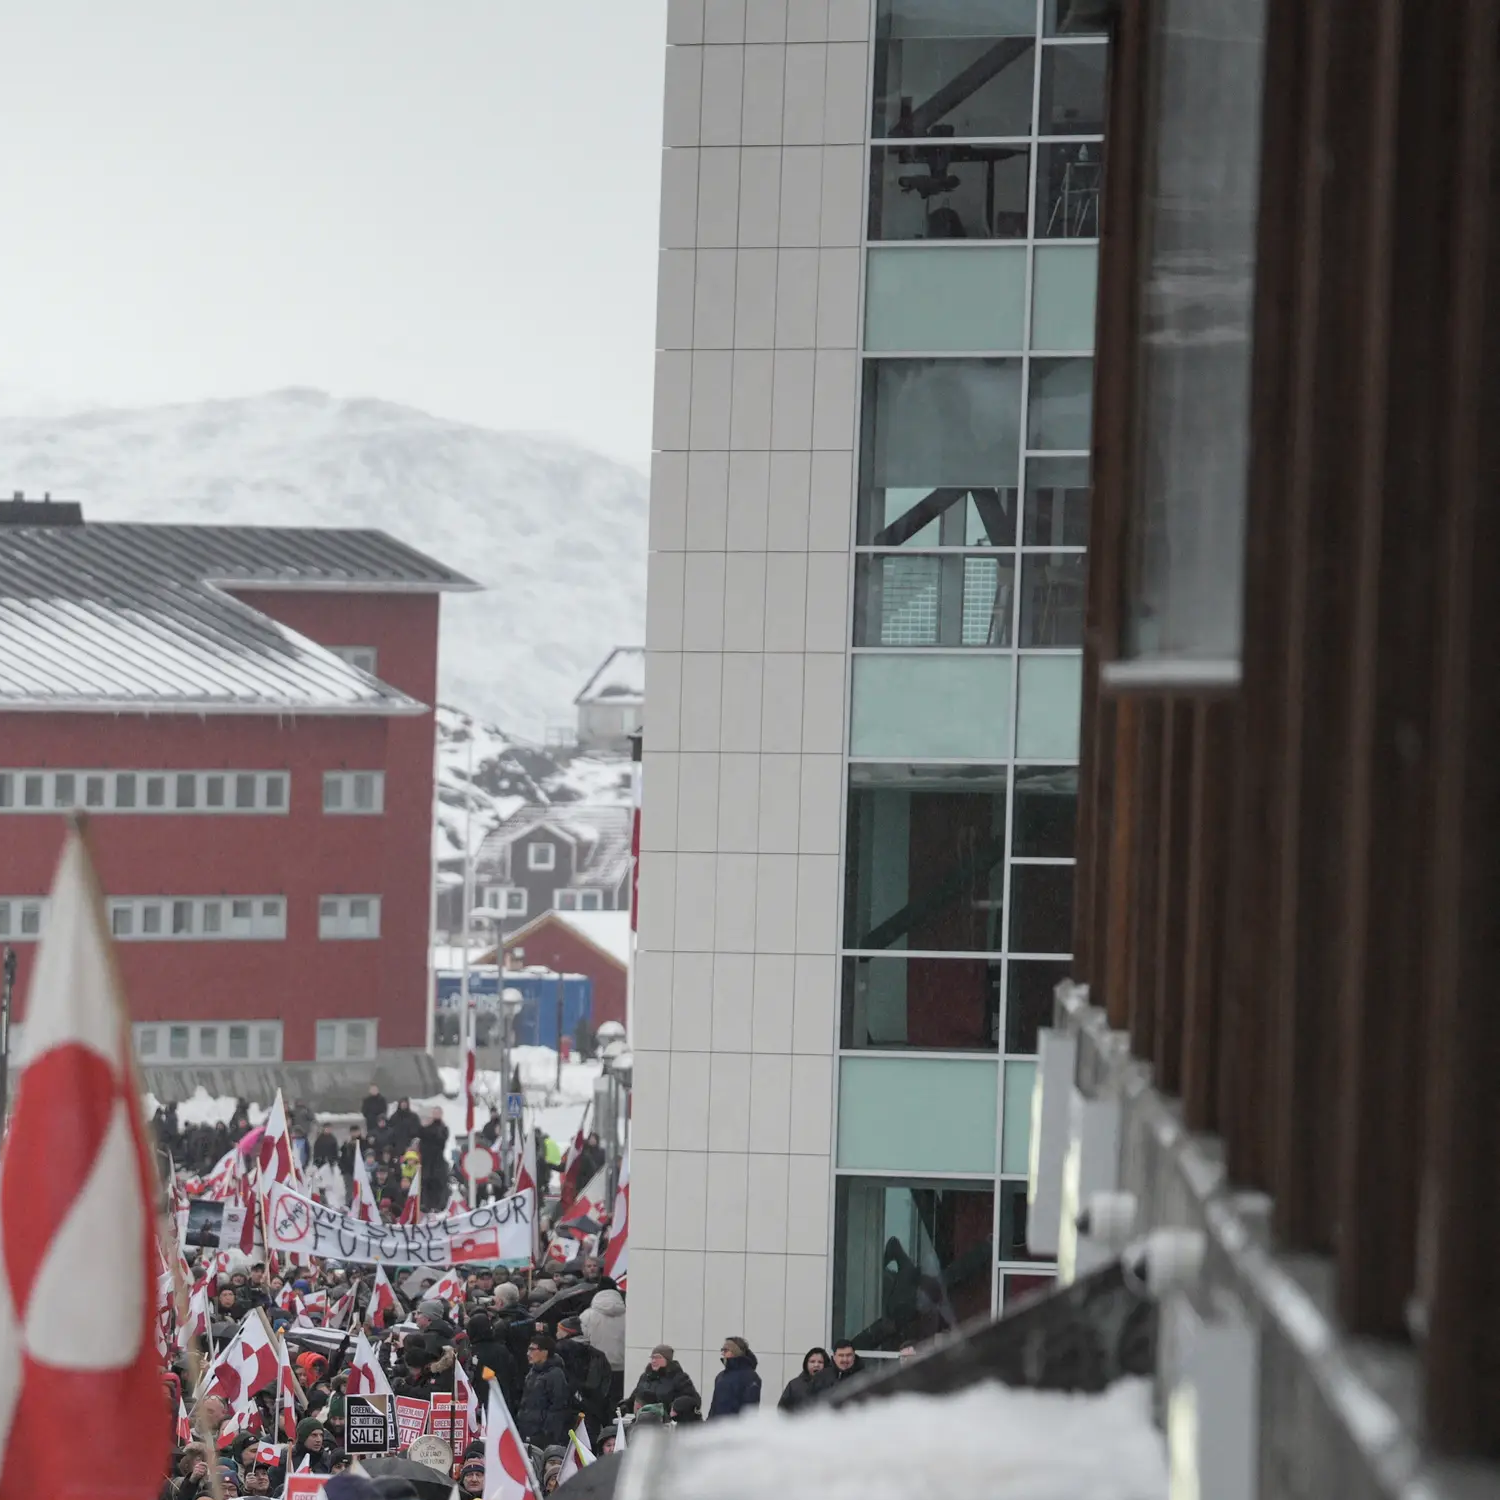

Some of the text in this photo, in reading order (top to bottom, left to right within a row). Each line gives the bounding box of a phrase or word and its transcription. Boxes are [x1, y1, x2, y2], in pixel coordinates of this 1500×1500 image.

[278, 1201, 304, 1235] TRUMP
[311, 1204, 354, 1232] WE
[470, 1195, 529, 1228] OUR
[312, 1222, 445, 1262] FUTURE
[351, 1417, 383, 1425] IS NOT FOR
[397, 1406, 425, 1417] GREENLAND
[351, 1429, 383, 1444] SALE!
